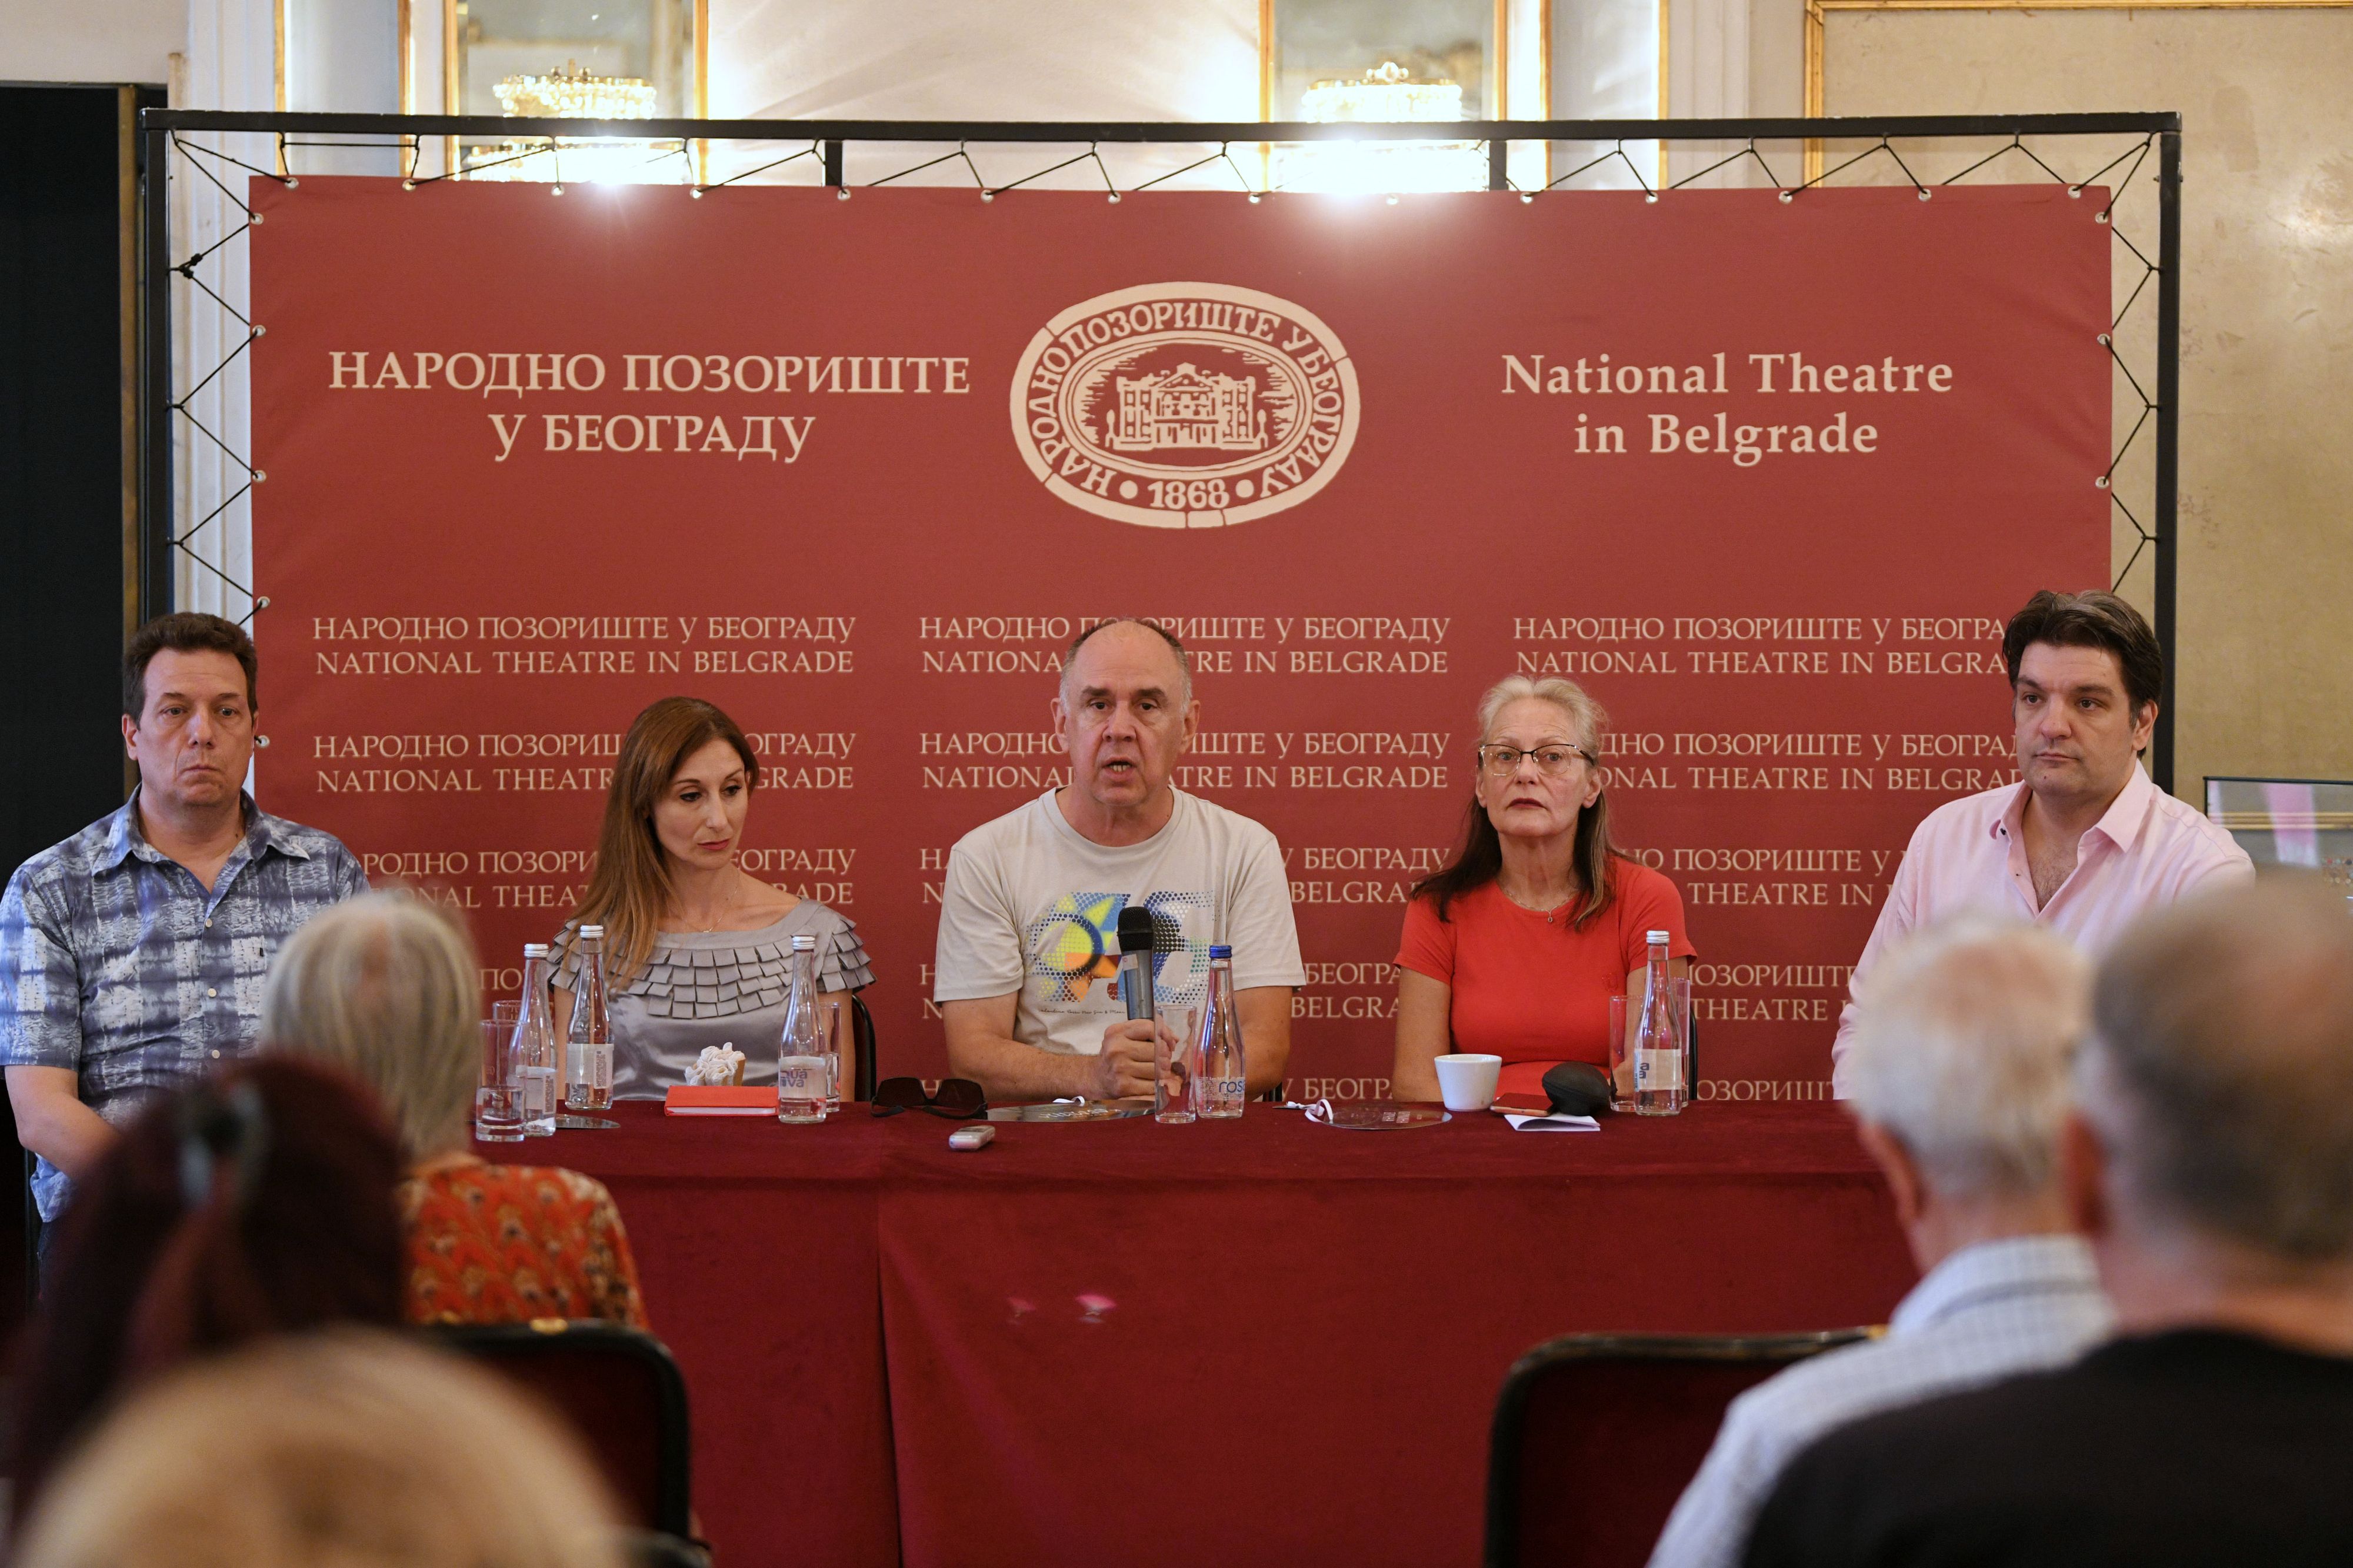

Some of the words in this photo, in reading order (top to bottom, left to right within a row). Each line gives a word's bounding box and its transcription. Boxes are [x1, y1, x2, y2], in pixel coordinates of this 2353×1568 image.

[328, 351, 606, 399] НАРОДНО
[622, 354, 970, 394] ПОЗОРИШТЕ
[1501, 352, 1729, 394] National
[1748, 351, 1953, 393] Theatre
[487, 413, 527, 462] У
[542, 414, 816, 464] БЕОГРАДУ
[1574, 413, 1627, 453] in
[1647, 411, 1878, 467] Belgrade
[1147, 479, 1229, 509] 1868
[313, 616, 469, 643] НАРОДНО
[478, 616, 669, 640] ПОЗОРИШТЕ
[678, 617, 698, 644] У
[707, 616, 856, 644] БЕОГРАДУ
[919, 616, 1070, 643] НАРОДНО
[1079, 617, 1265, 640] ПРИШТЕ
[1274, 618, 1294, 644] У
[1304, 617, 1451, 644] БЕОГРАДУ
[1514, 618, 1665, 643] НАРОДНО
[1674, 618, 1862, 640] ПОЗОРИШТЕ
[1871, 618, 1891, 645] У
[1901, 618, 2006, 640] БЕОГРА
[316, 651, 481, 675] NATIONAL
[492, 651, 635, 673] THEATRE
[648, 651, 681, 673] IN
[693, 650, 854, 673] BELGRADE
[922, 650, 1062, 674] NATIONA
[1244, 651, 1277, 673] IN
[1289, 650, 1448, 673] BELGRADE
[1517, 652, 1677, 675] NATIONAL
[1687, 652, 1828, 674] THEATRE
[1841, 652, 1874, 674] IN
[1887, 652, 2007, 674] BELGRA
[314, 734, 469, 760] НАРОДНО
[478, 733, 622, 757] ПОЗОРИШ
[745, 733, 856, 760] ОГРАДУ
[1275, 733, 1294, 759] У
[1304, 732, 1450, 759] БЕОГРАДУ
[1674, 733, 1862, 756] ПОЗОРИШТЕ
[1872, 734, 1891, 761] У
[1901, 733, 2017, 760] БЕОГРА
[317, 769, 481, 792] NATIONAL
[493, 768, 614, 791] THEATR
[1244, 766, 1277, 788] IN
[1290, 766, 1448, 789] BELGRADE
[1688, 767, 1828, 790] THEATRE
[1841, 768, 1874, 790] IN
[1887, 768, 2019, 790] BELGRA
[361, 852, 469, 878] РОДНО
[478, 850, 598, 874] ПОЗОРИ
[731, 848, 856, 875] ОГРАДУ
[1304, 848, 1450, 874] БЕОГРАДУ
[1674, 848, 1861, 871] ПОЗОРИШТЕ
[1871, 849, 1891, 877] У
[492, 885, 589, 908] THEA
[1289, 881, 1422, 903] BELGRA
[1687, 882, 1828, 905] THEATRE
[1840, 883, 1874, 906] IN
[1688, 964, 1857, 987] ОЗОРИШТ
[1688, 998, 1828, 1021] THEATRE
[1219, 1081, 1245, 1094] ros
[1304, 1078, 1393, 1100] БЕОГР
